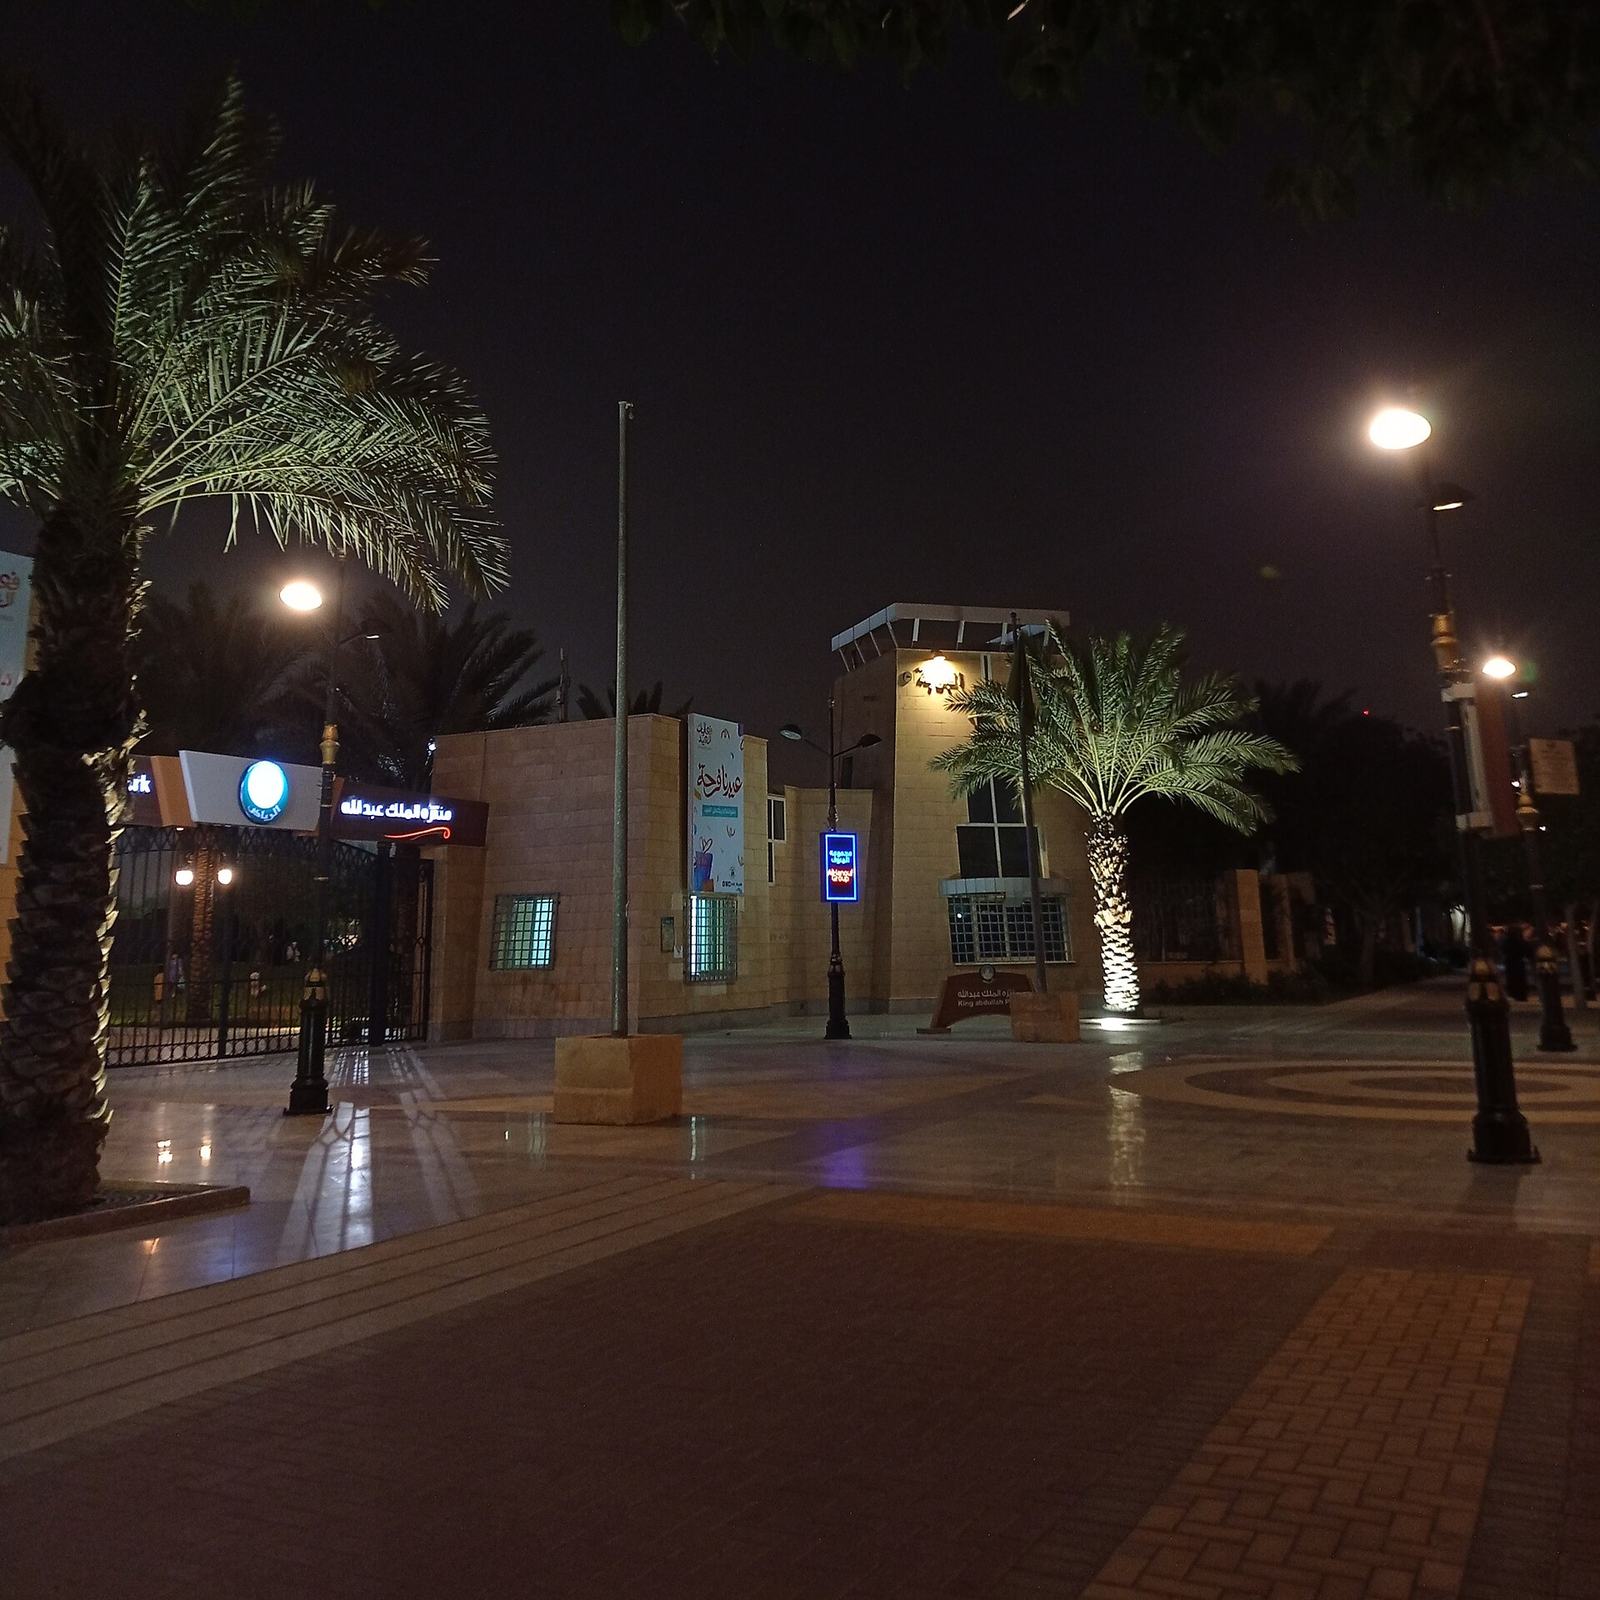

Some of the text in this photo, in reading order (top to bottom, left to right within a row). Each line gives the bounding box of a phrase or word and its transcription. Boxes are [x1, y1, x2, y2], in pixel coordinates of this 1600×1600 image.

[697, 763, 721, 798] فرحة
[385, 803, 420, 819] الملك
[420, 803, 452, 823] منتزه
[981, 989, 1001, 998] الملك
[957, 999, 974, 1008] King
